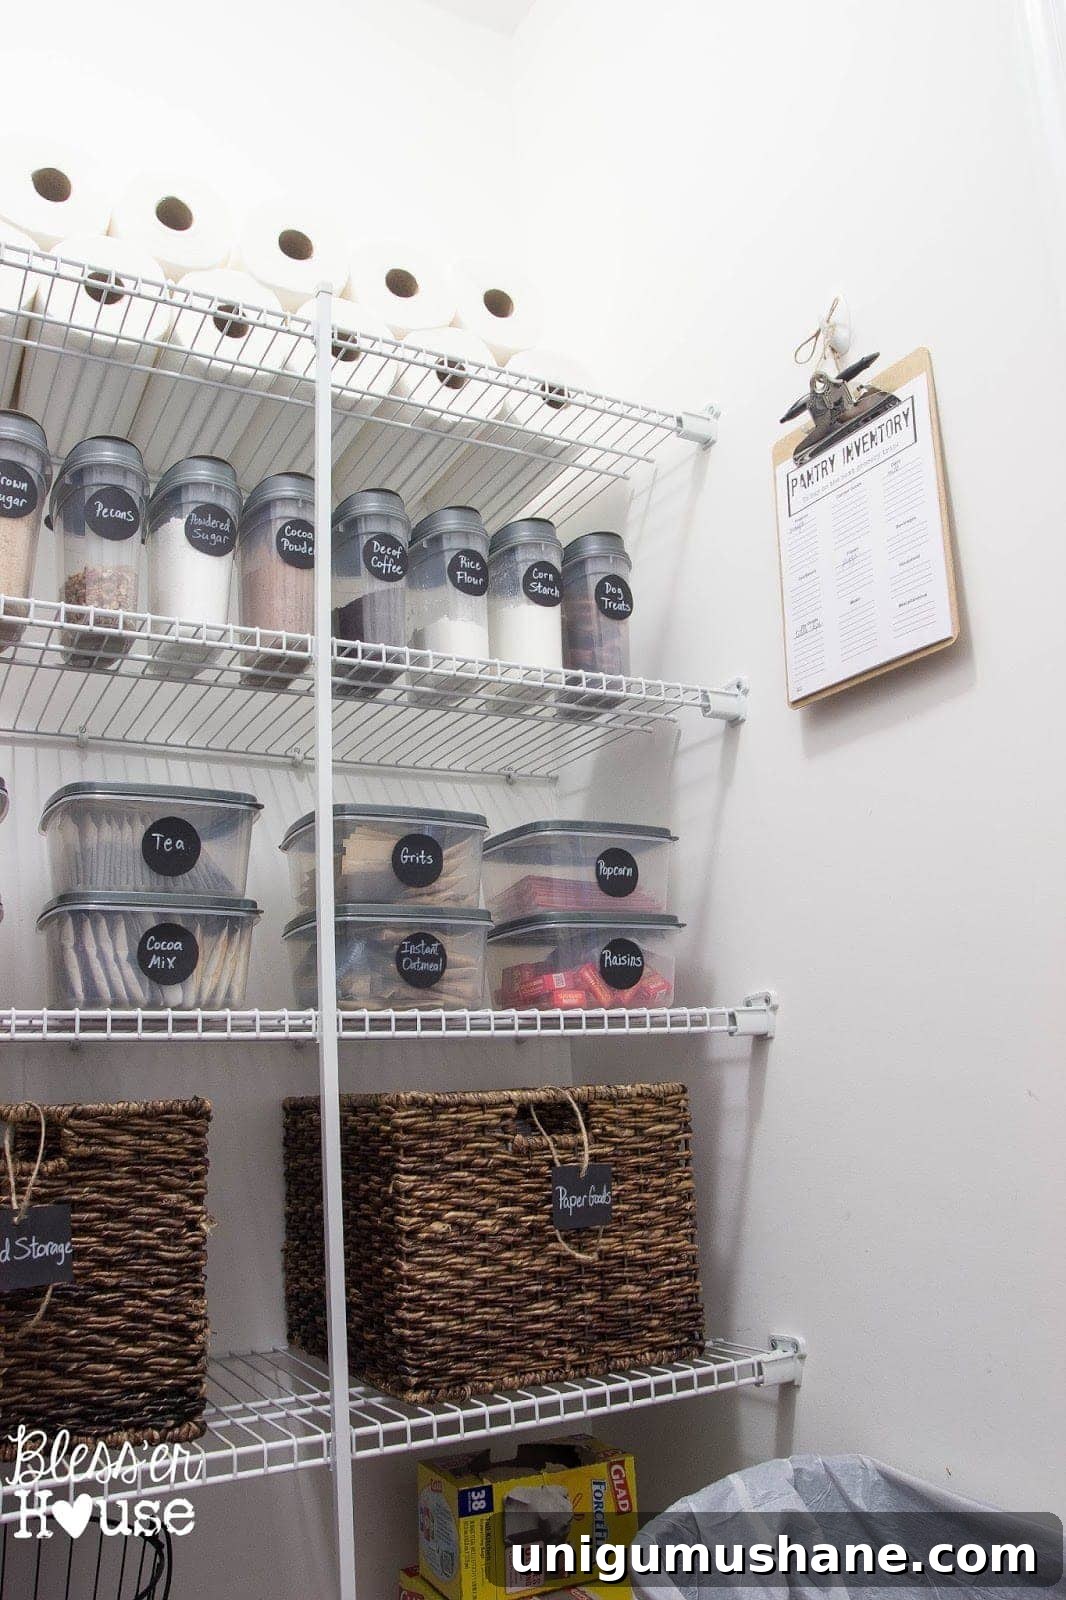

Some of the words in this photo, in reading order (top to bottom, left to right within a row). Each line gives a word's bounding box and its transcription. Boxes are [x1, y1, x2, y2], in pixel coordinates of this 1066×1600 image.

[791, 455, 836, 498] PANTRY
[842, 407, 910, 465] INVENTORY
[0, 472, 28, 492] rown
[0, 494, 28, 510] ugar
[94, 501, 135, 522] Pecans
[189, 513, 231, 533] Powdered
[191, 528, 229, 545] Sugar
[284, 525, 314, 541] Cocoa
[280, 537, 314, 556] Powde
[371, 555, 404, 576] Coffee
[459, 555, 481, 571] Rice
[456, 571, 484, 586] Flour
[532, 568, 554, 582] Corn
[528, 582, 560, 598] Starch
[604, 582, 624, 600] Dog
[601, 597, 631, 612] Treats
[151, 833, 185, 851] Tea
[400, 847, 434, 865] Grits
[598, 859, 634, 879] Popcorn
[146, 935, 183, 952] Cocoa
[401, 941, 441, 956] Instant
[148, 957, 175, 970] Mix
[402, 956, 443, 973] Oatmeal
[601, 950, 644, 969] Raisins
[555, 1185, 586, 1217] Paper
[588, 1184, 612, 1208] Goods
[13, 1235, 74, 1266] Storage
[610, 1464, 631, 1513] GLAD
[471, 1488, 487, 1512] 38
